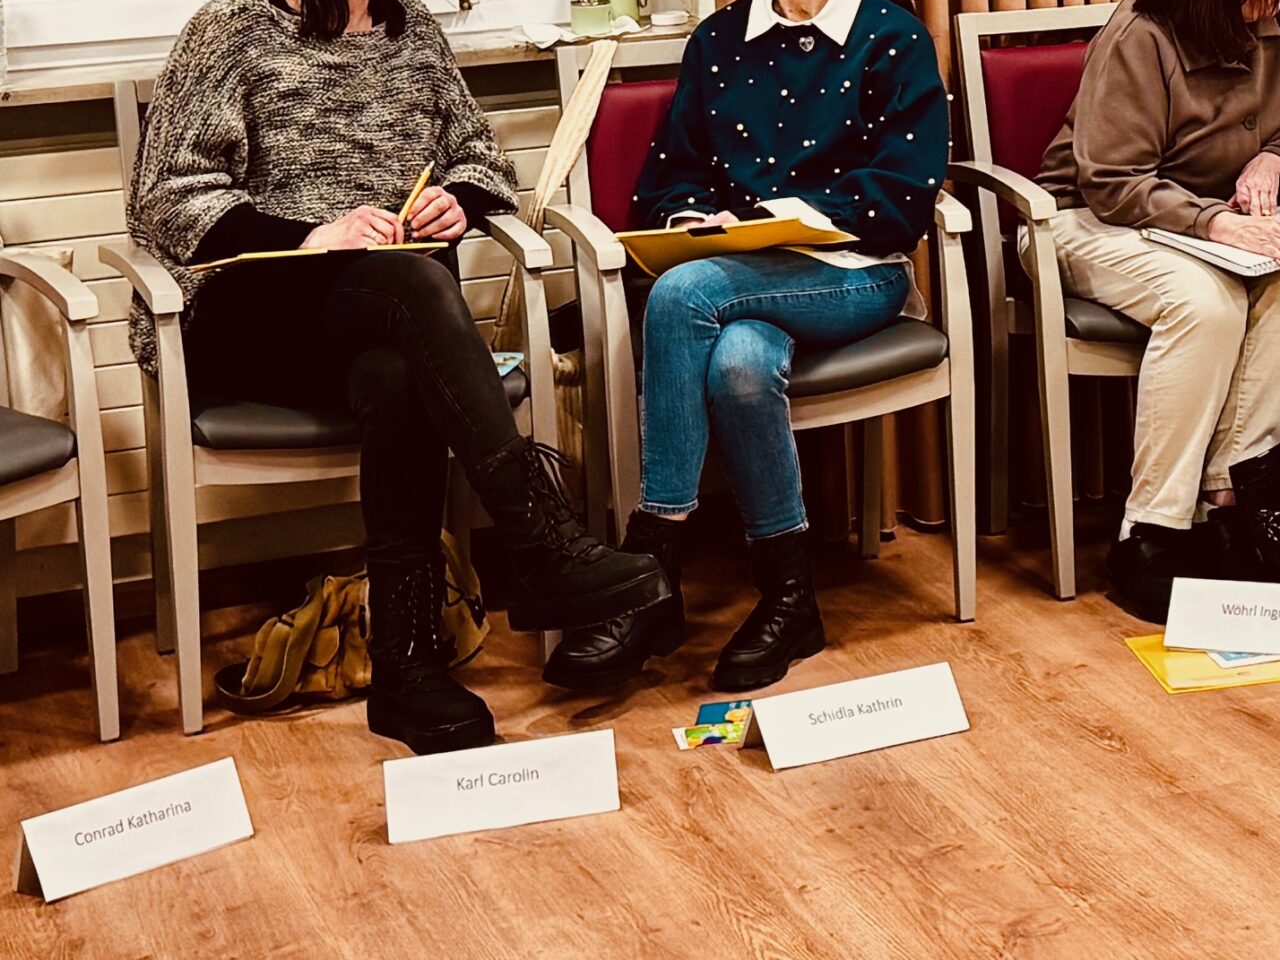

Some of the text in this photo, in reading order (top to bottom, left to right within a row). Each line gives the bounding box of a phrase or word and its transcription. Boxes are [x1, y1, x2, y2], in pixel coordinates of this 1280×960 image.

[1221, 602, 1258, 617] Wöhrl
[808, 696, 904, 726] Schidla Kathrin
[456, 767, 540, 791] Karl Carolin
[73, 799, 193, 847] Conrad Katharina
